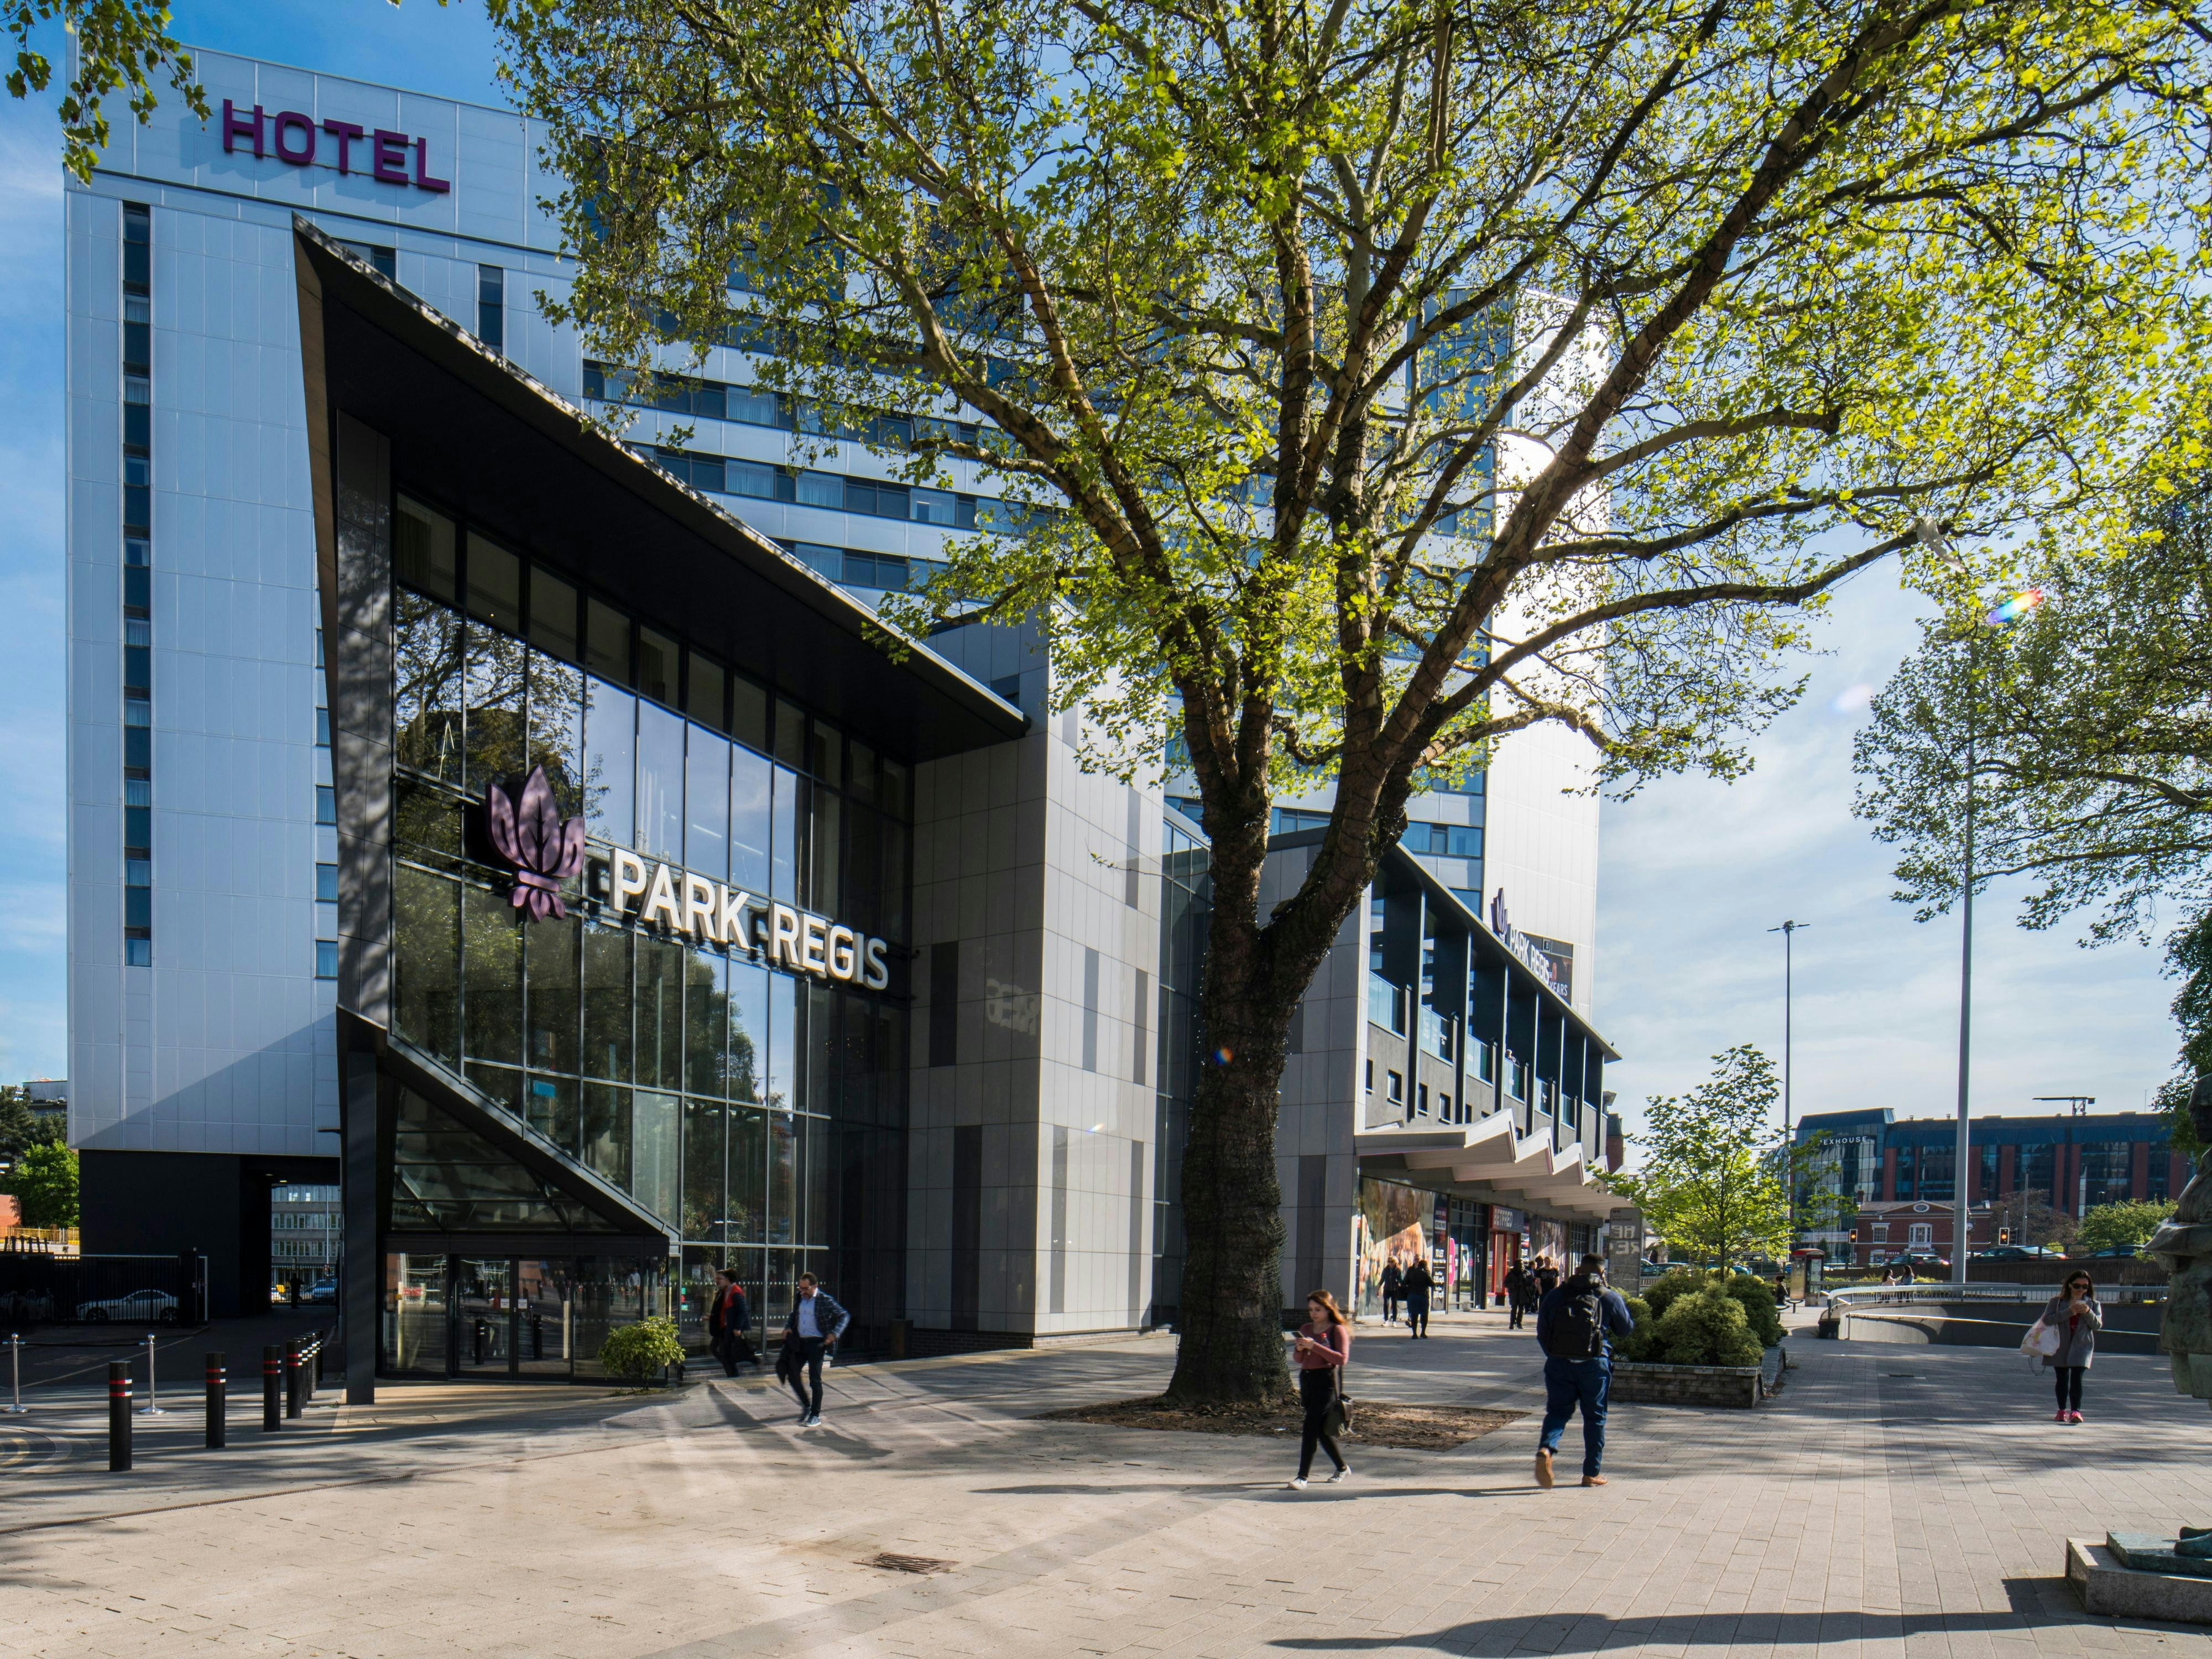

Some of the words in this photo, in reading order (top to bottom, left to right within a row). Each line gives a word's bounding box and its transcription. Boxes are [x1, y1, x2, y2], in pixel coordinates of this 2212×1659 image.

[223, 98, 450, 193] HOTEL
[609, 847, 750, 950] PARK
[768, 902, 889, 990] REGIS
[1510, 926, 1530, 966] PARK
[1530, 944, 1549, 985] REGIS
[1550, 982, 1568, 996] YEARS
[1494, 1208, 1513, 1228] BETFRED
